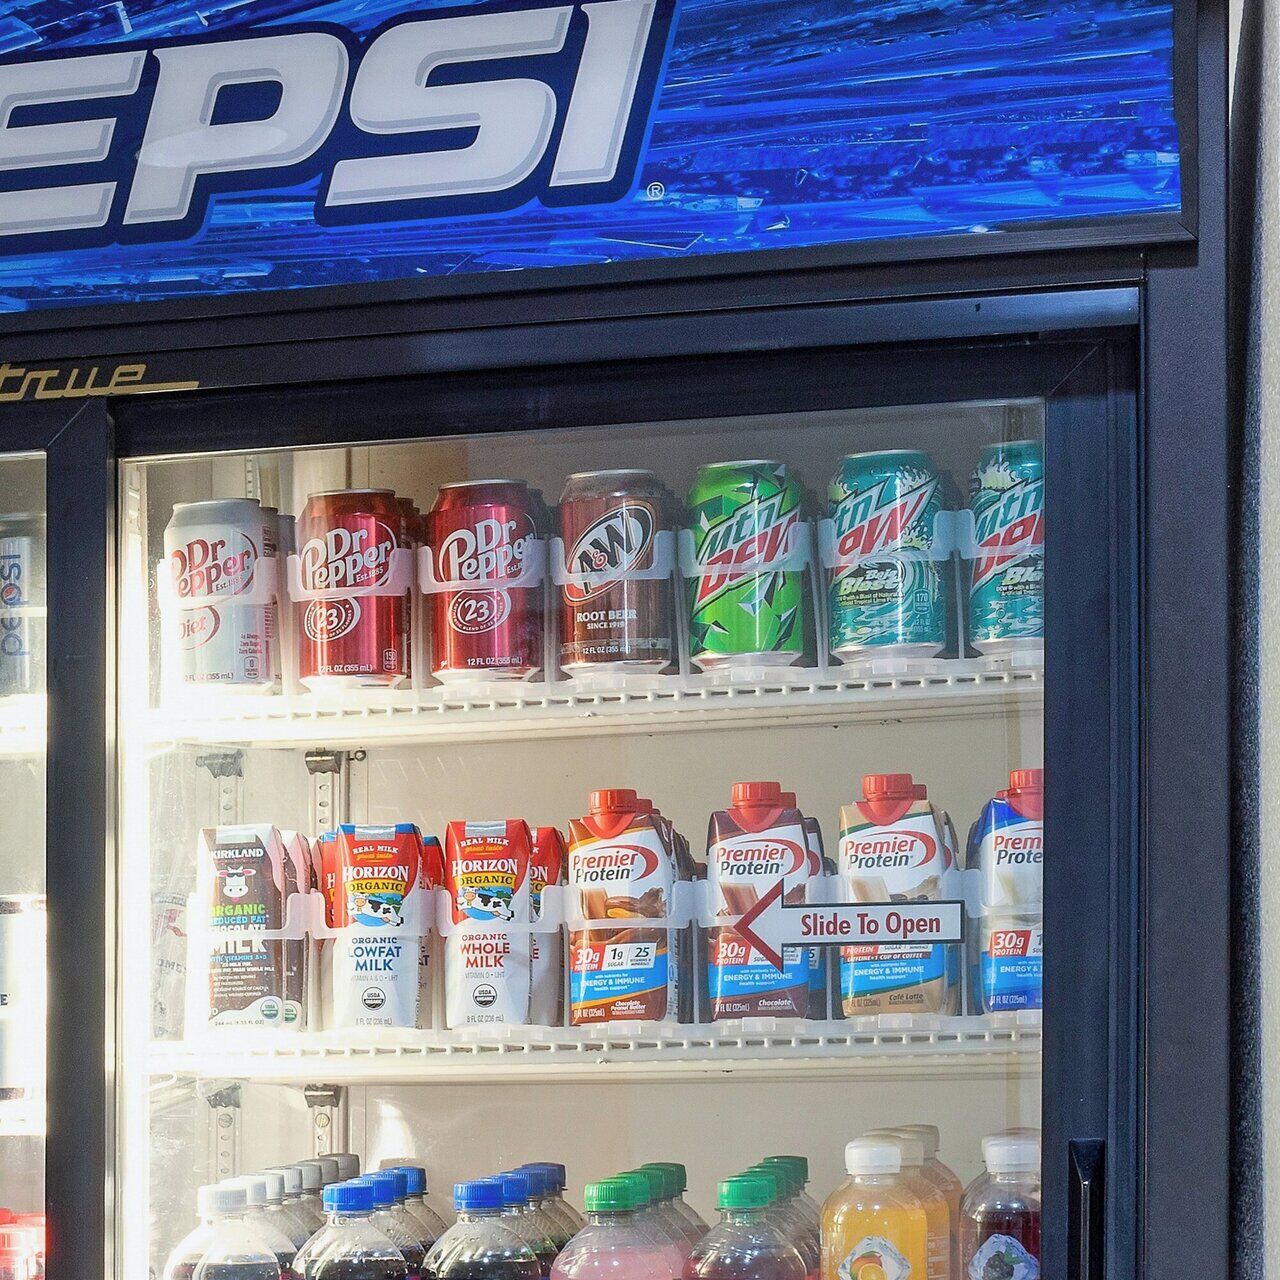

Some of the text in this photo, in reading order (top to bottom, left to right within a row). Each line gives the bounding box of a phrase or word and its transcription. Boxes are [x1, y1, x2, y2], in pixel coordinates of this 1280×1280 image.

[475, 518, 516, 551] Dr
[327, 527, 368, 562] Dr
[440, 530, 537, 582] Pepper
[301, 541, 390, 590] Pepper
[464, 600, 489, 620] 23
[577, 609, 637, 623] ROOT BEER
[352, 844, 399, 855] REAL MILK
[460, 837, 510, 847] REAL MILK
[844, 837, 917, 860] Premier
[210, 847, 264, 859] KIRKLAND
[716, 844, 788, 866] Premier
[848, 852, 914, 869] Protein
[452, 859, 518, 875] HORIZON
[573, 851, 639, 877] Premier
[720, 860, 784, 876] Protein
[344, 866, 409, 882] HORIZON
[459, 875, 513, 888] ORGANIC
[575, 866, 634, 882] Protein
[349, 881, 404, 892] ORGANIC
[801, 914, 941, 938] Slide To Open
[351, 937, 398, 945] ORGANIC
[461, 934, 508, 942] ORGANIC
[348, 946, 402, 959] LOWFAT
[460, 942, 511, 955] WHOLE
[355, 959, 394, 971] MILK
[465, 955, 504, 968] MILK
[854, 967, 884, 975] ENERGY
[892, 966, 924, 974] IMMUNE
